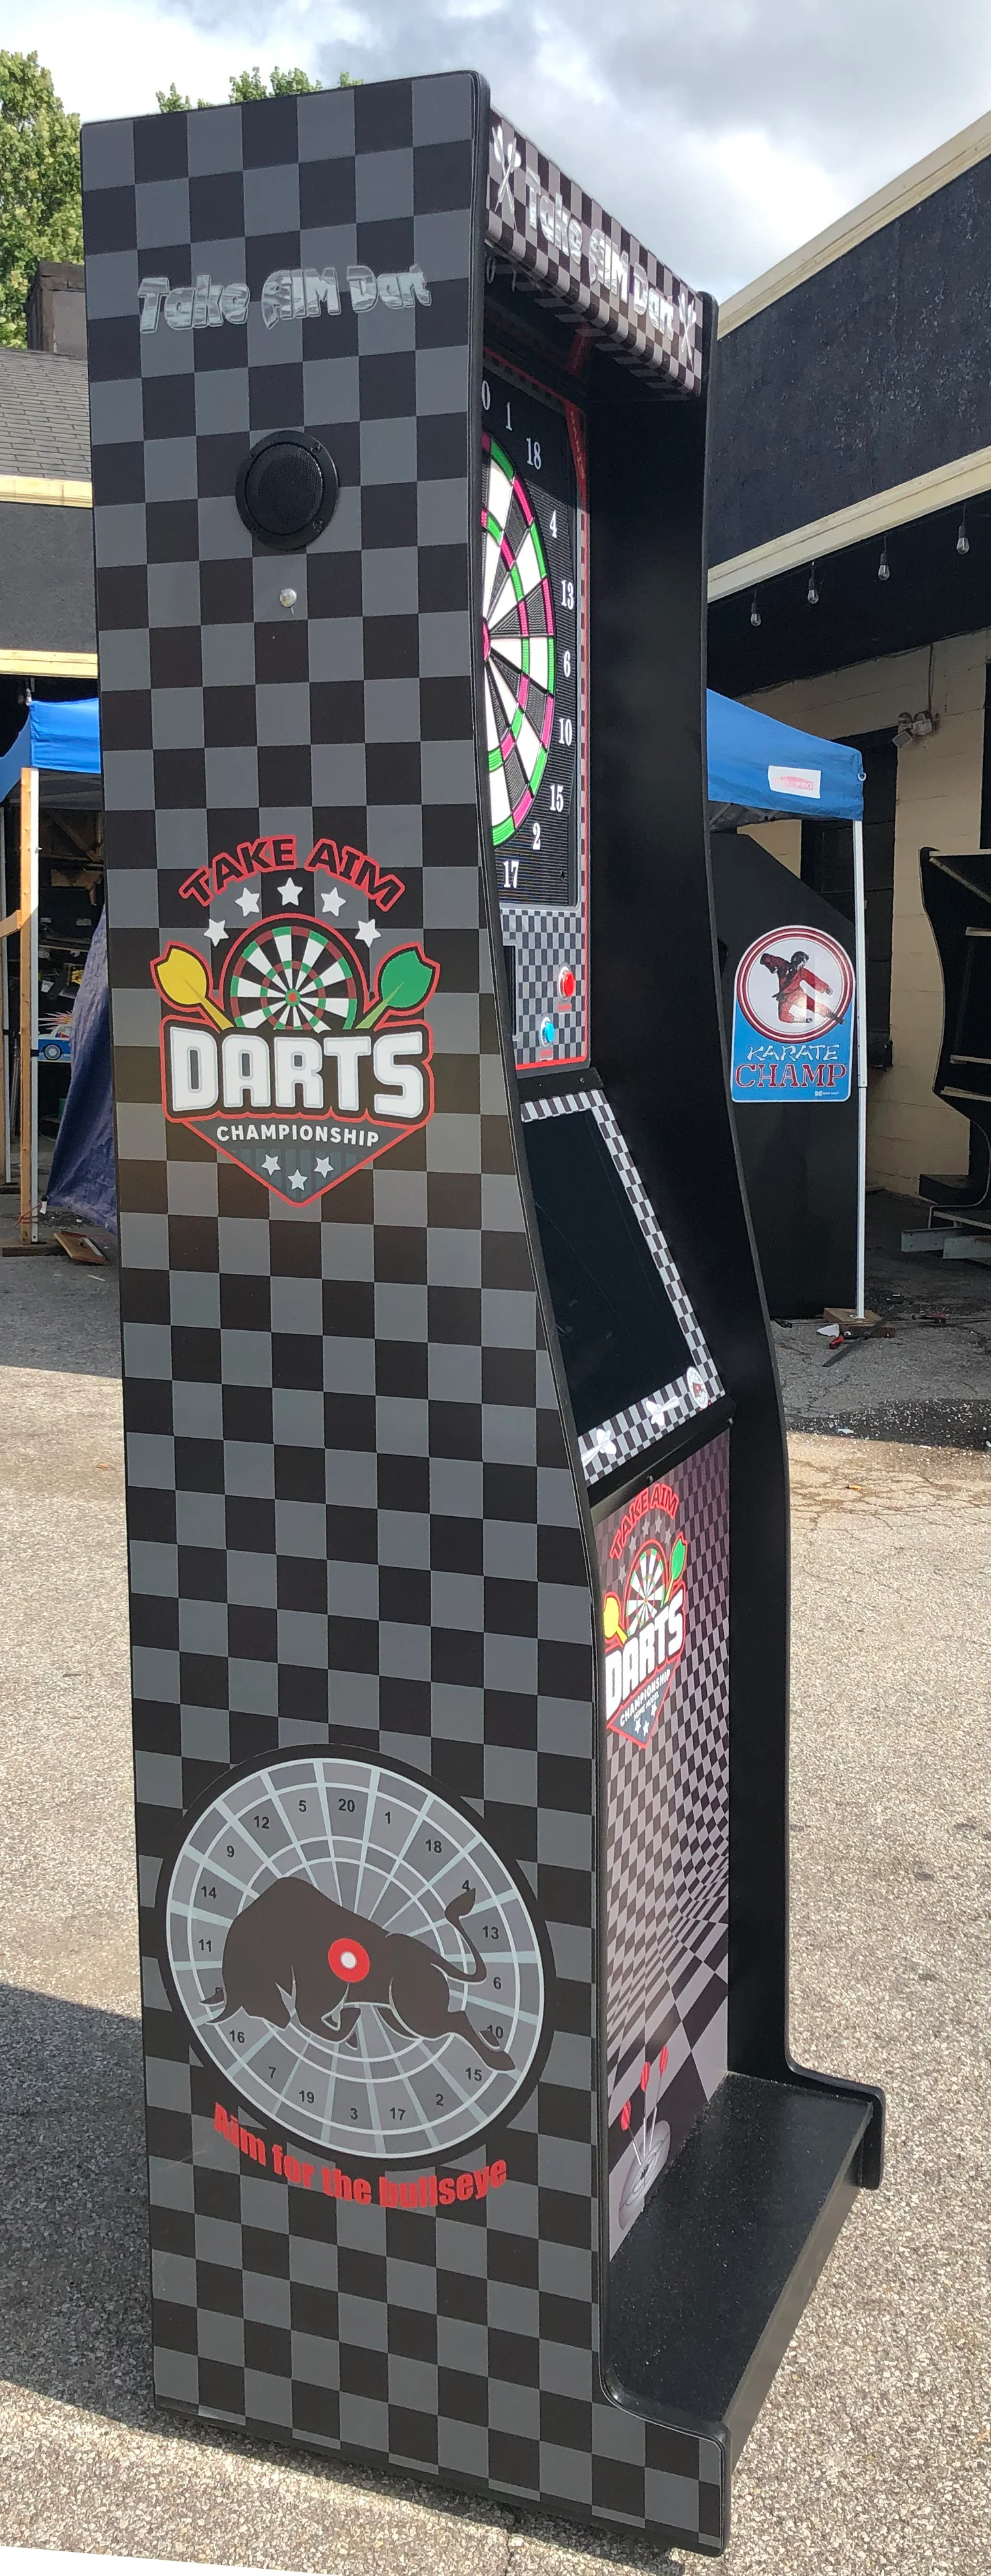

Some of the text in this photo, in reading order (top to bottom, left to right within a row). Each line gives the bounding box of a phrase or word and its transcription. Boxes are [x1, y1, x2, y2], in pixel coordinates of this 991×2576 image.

[525, 166, 583, 266] Take
[633, 261, 674, 342] Dart
[137, 264, 432, 334] Take AIM Dart
[506, 402, 513, 431] 1
[526, 437, 542, 470] 18
[549, 510, 557, 539] 4
[560, 579, 574, 610] 13
[563, 651, 571, 678] 6
[559, 718, 572, 746] 10
[549, 784, 564, 812] 15
[532, 822, 541, 851] 2
[178, 835, 405, 912] TAKE AIM
[503, 860, 520, 889] 17
[747, 1044, 840, 1062] KARATE
[169, 1025, 425, 1119] DARTS
[735, 1063, 847, 1088] CHAMP
[216, 1124, 380, 1147] CHAMPIONSHIP
[609, 1482, 680, 1559] TAKE AIM
[605, 1589, 685, 1722] DARTS
[620, 1668, 671, 1727] CHAMPIONSHIP
[299, 1800, 306, 1813] 5
[338, 1798, 355, 1813] 20
[253, 1815, 270, 1829] 12
[384, 1811, 392, 1824] 1
[226, 1845, 235, 1858] 9
[425, 1839, 443, 1854] 18
[201, 1886, 218, 1900] 14
[461, 1879, 470, 1892] 4
[482, 1926, 499, 1939] 13
[199, 1939, 212, 1952] 11
[493, 1977, 502, 1990] 6
[229, 2030, 246, 2043] 16
[268, 2067, 276, 2079] 7
[465, 2067, 483, 2081] 15
[299, 2091, 315, 2104] 19
[436, 2093, 444, 2106] 2
[349, 2108, 358, 2120] 3
[389, 2107, 406, 2120] 17
[214, 2102, 507, 2208] Aim for the bullseye
